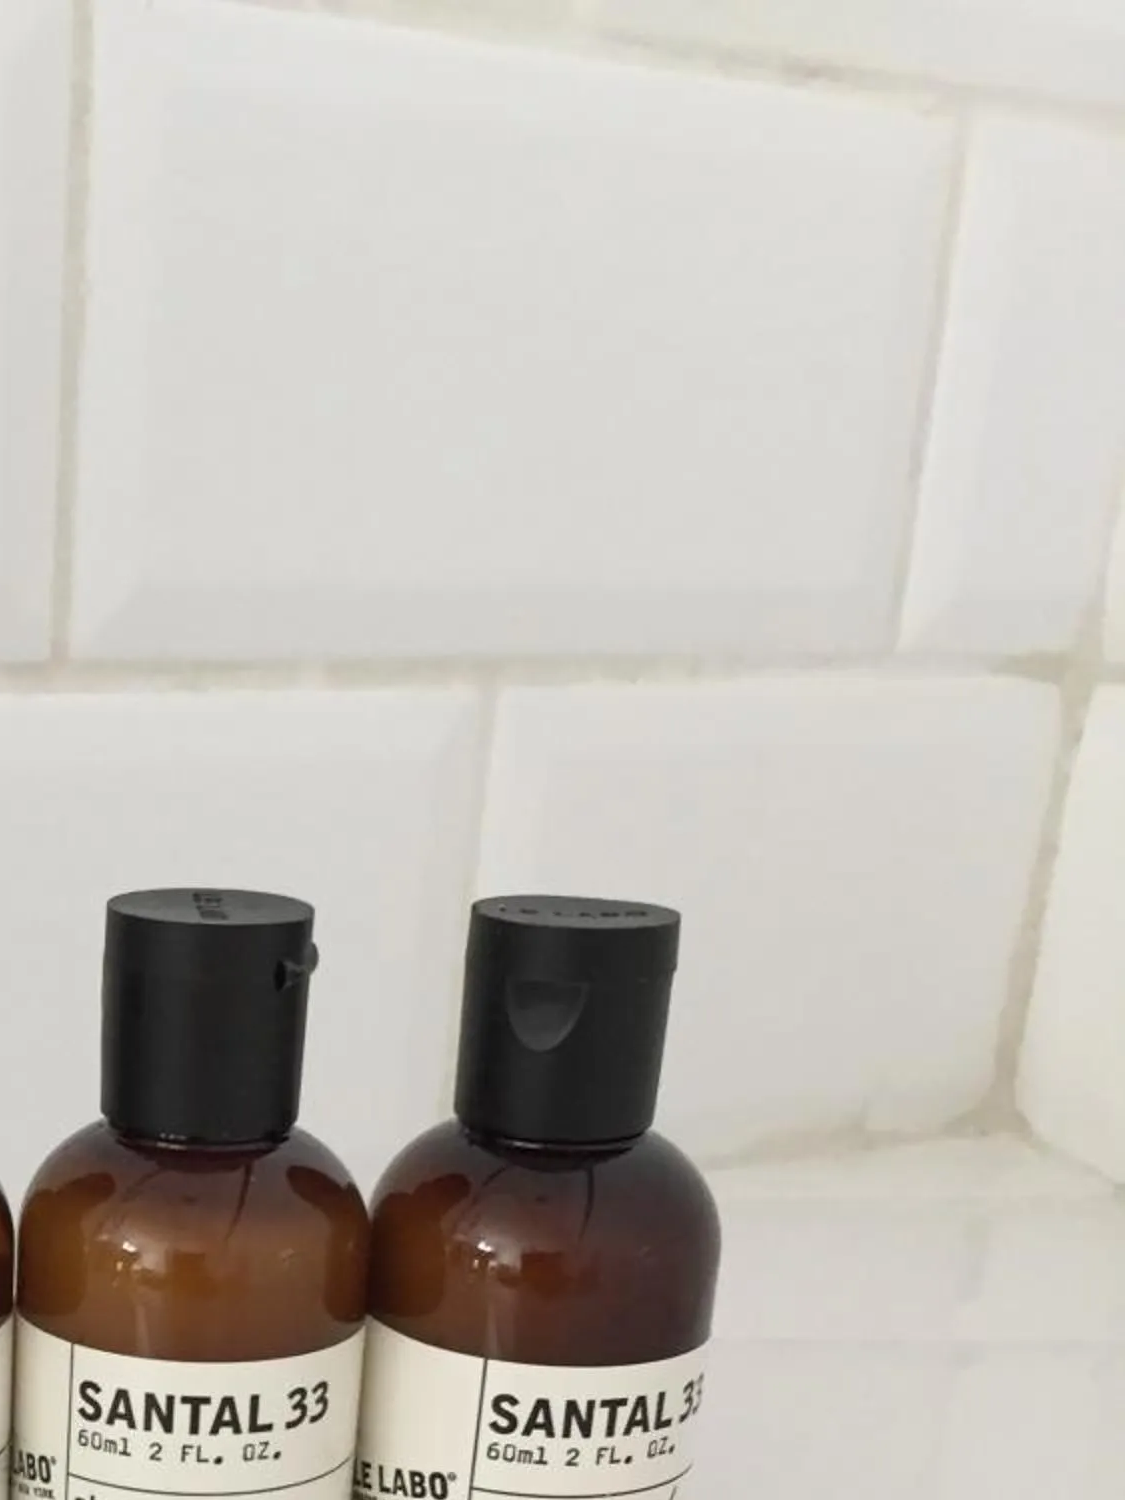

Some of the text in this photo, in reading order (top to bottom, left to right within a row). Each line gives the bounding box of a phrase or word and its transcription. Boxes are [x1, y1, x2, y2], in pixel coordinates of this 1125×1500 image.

[77, 1381, 329, 1436] SANTAL 33
[488, 1392, 673, 1439] SANTAL
[77, 1429, 282, 1465] 60ml 2 FL. OZ.
[486, 1436, 674, 1466] 60ml 2 FL. OZ.
